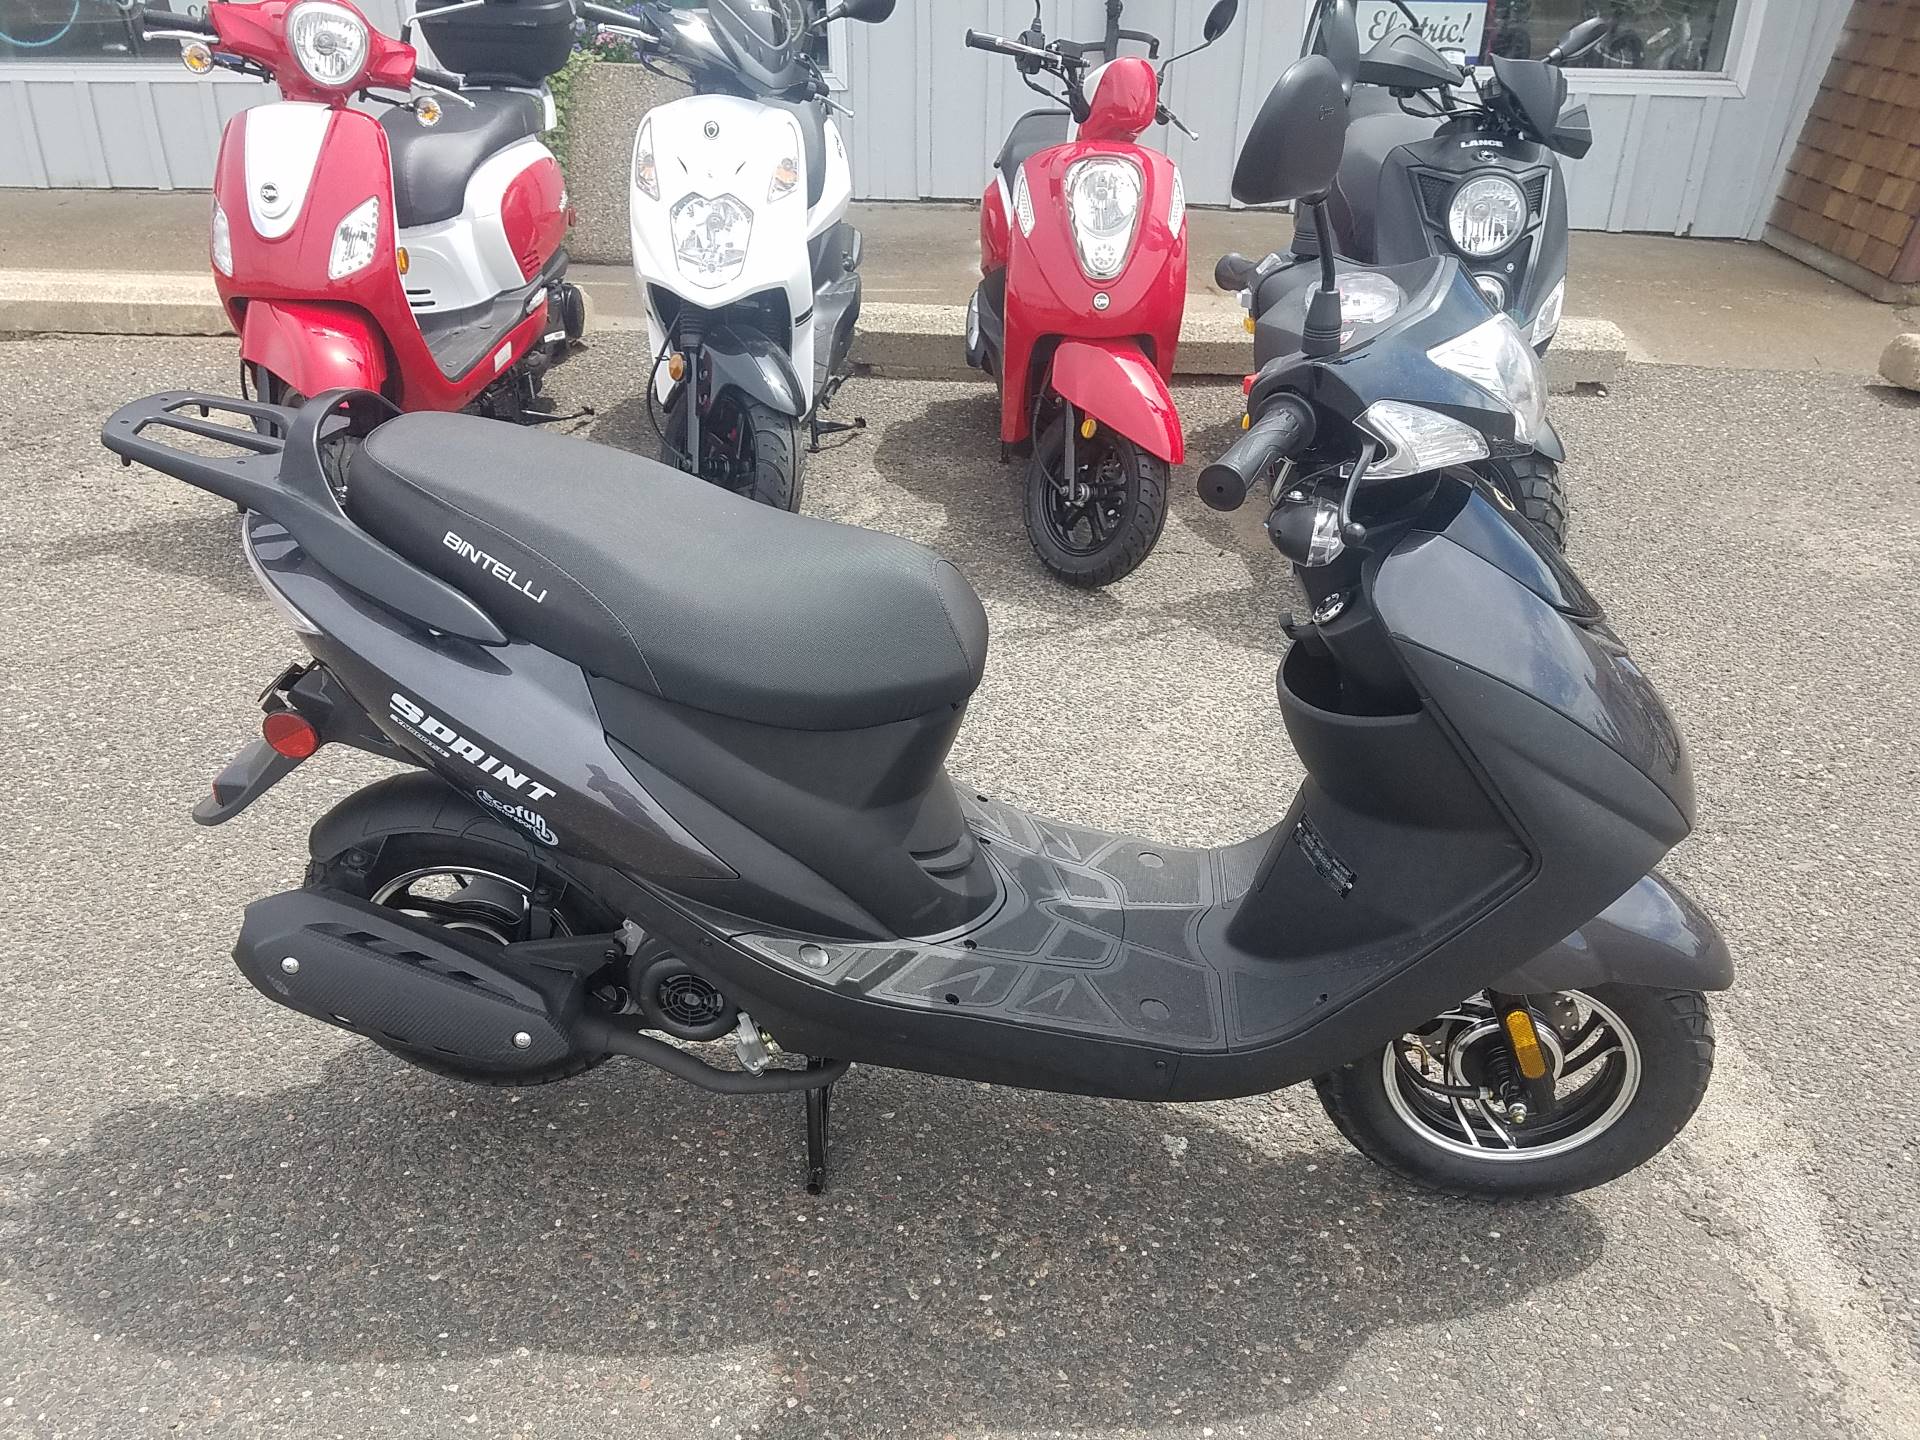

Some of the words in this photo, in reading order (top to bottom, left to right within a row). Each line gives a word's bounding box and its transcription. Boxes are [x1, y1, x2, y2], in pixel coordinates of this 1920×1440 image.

[1368, 10, 1472, 43] Eltric!
[1460, 139, 1505, 148] LANCE
[442, 530, 548, 603] BINTELLI
[389, 692, 557, 801] SPRINT
